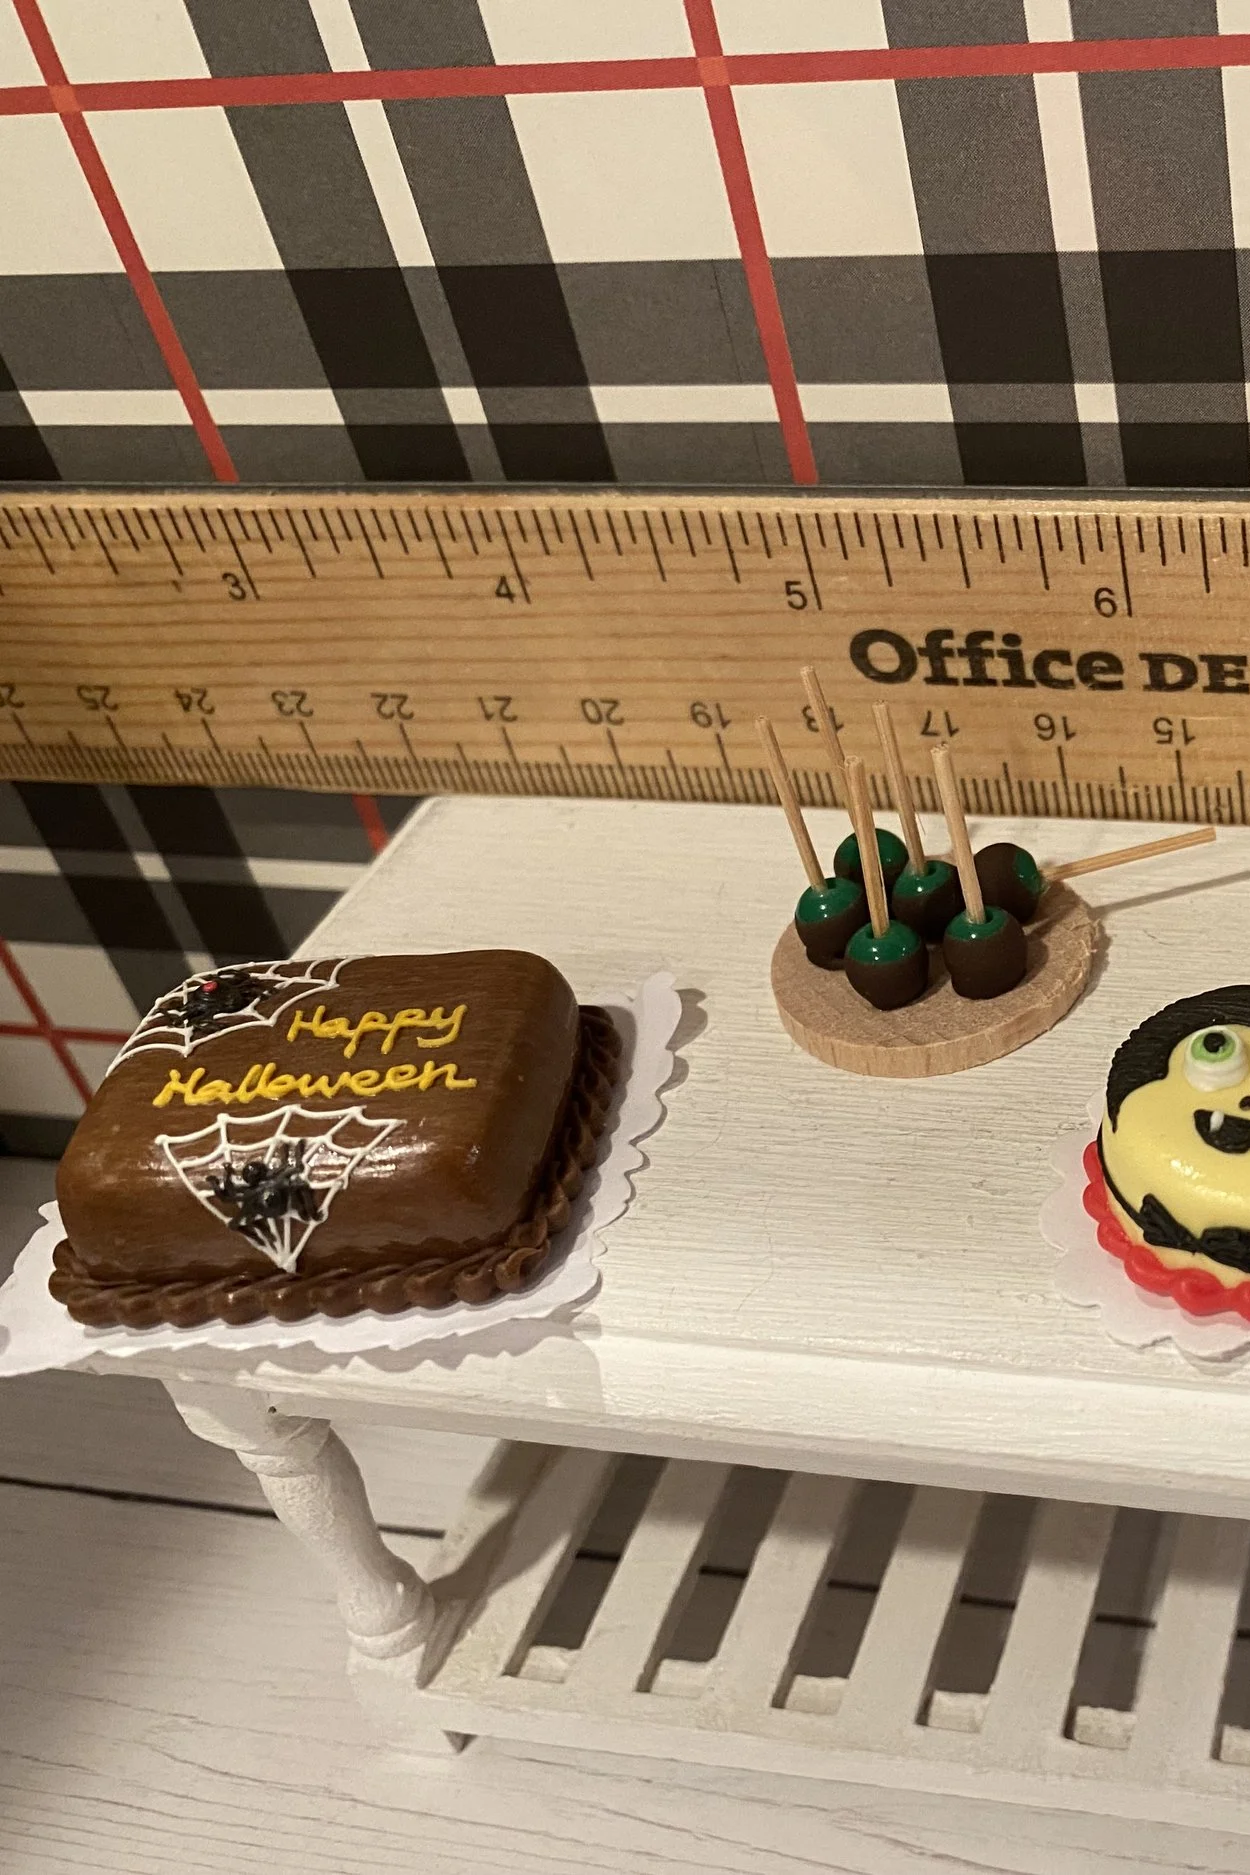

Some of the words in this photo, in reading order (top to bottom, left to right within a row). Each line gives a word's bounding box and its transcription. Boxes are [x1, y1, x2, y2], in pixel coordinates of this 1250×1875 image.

[222, 573, 246, 600] 3
[494, 577, 515, 602] 4
[784, 581, 808, 610] 5
[1094, 588, 1118, 618] 6
[849, 629, 1124, 691] Office
[0, 684, 25, 710] 2
[76, 685, 119, 711] 25
[175, 688, 215, 715] 24
[270, 690, 314, 718] 23
[375, 693, 415, 721] 22
[476, 696, 518, 723] 21
[580, 698, 625, 726] 20
[690, 701, 731, 730] 19
[920, 710, 959, 738] 17
[1034, 713, 1077, 742] 16
[1153, 717, 1196, 746] 15
[286, 1004, 468, 1058] Happy
[152, 1062, 477, 1107] Halloween
